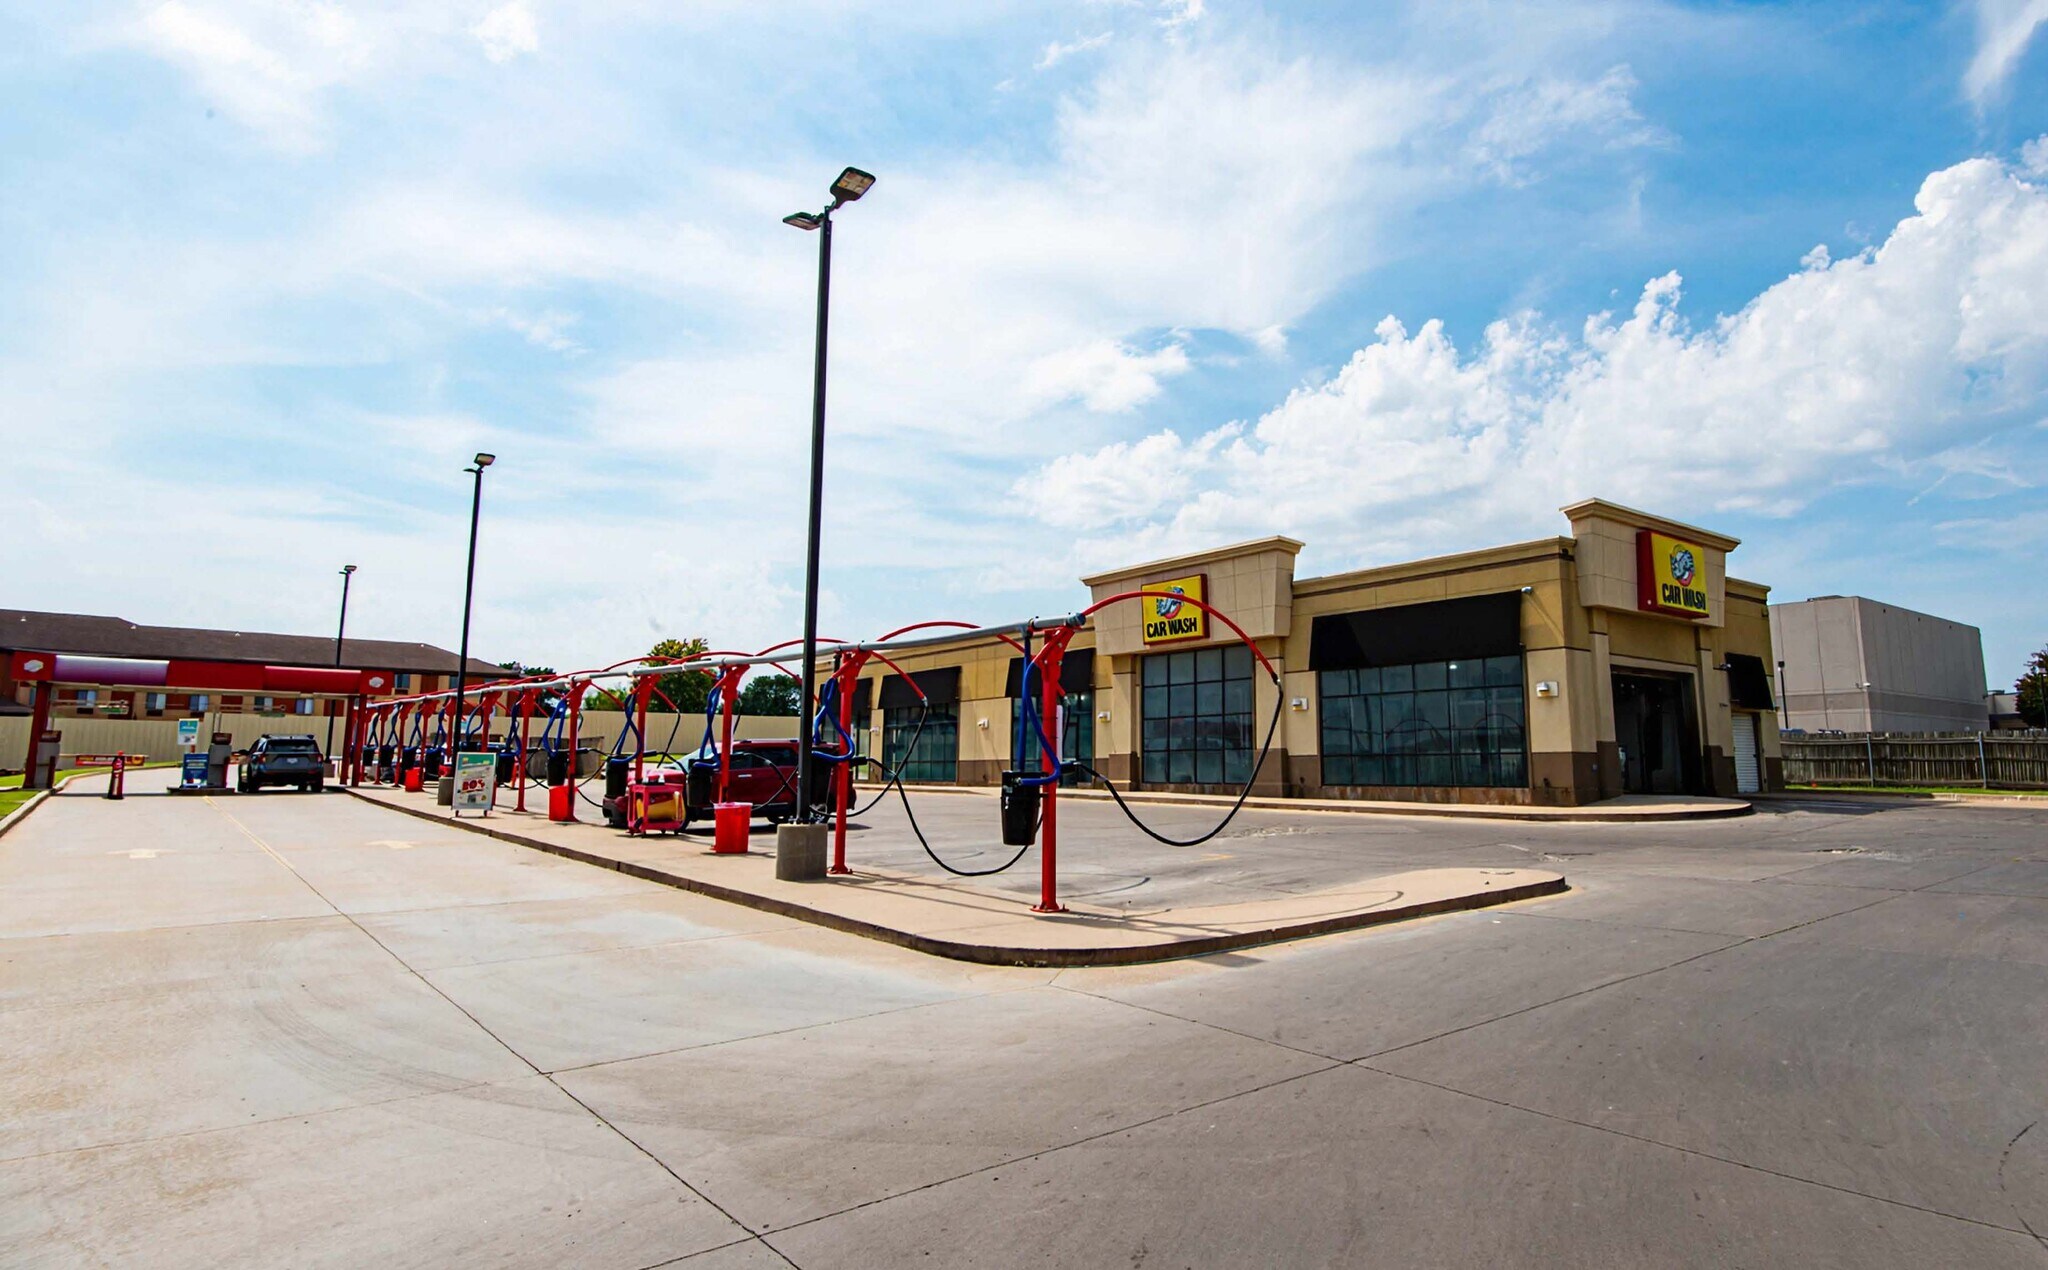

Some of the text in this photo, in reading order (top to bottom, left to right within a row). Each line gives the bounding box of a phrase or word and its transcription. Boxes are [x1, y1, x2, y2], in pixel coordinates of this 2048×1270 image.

[1662, 583, 1706, 611] CAR WASH
[1146, 617, 1198, 638] CAR WASH
